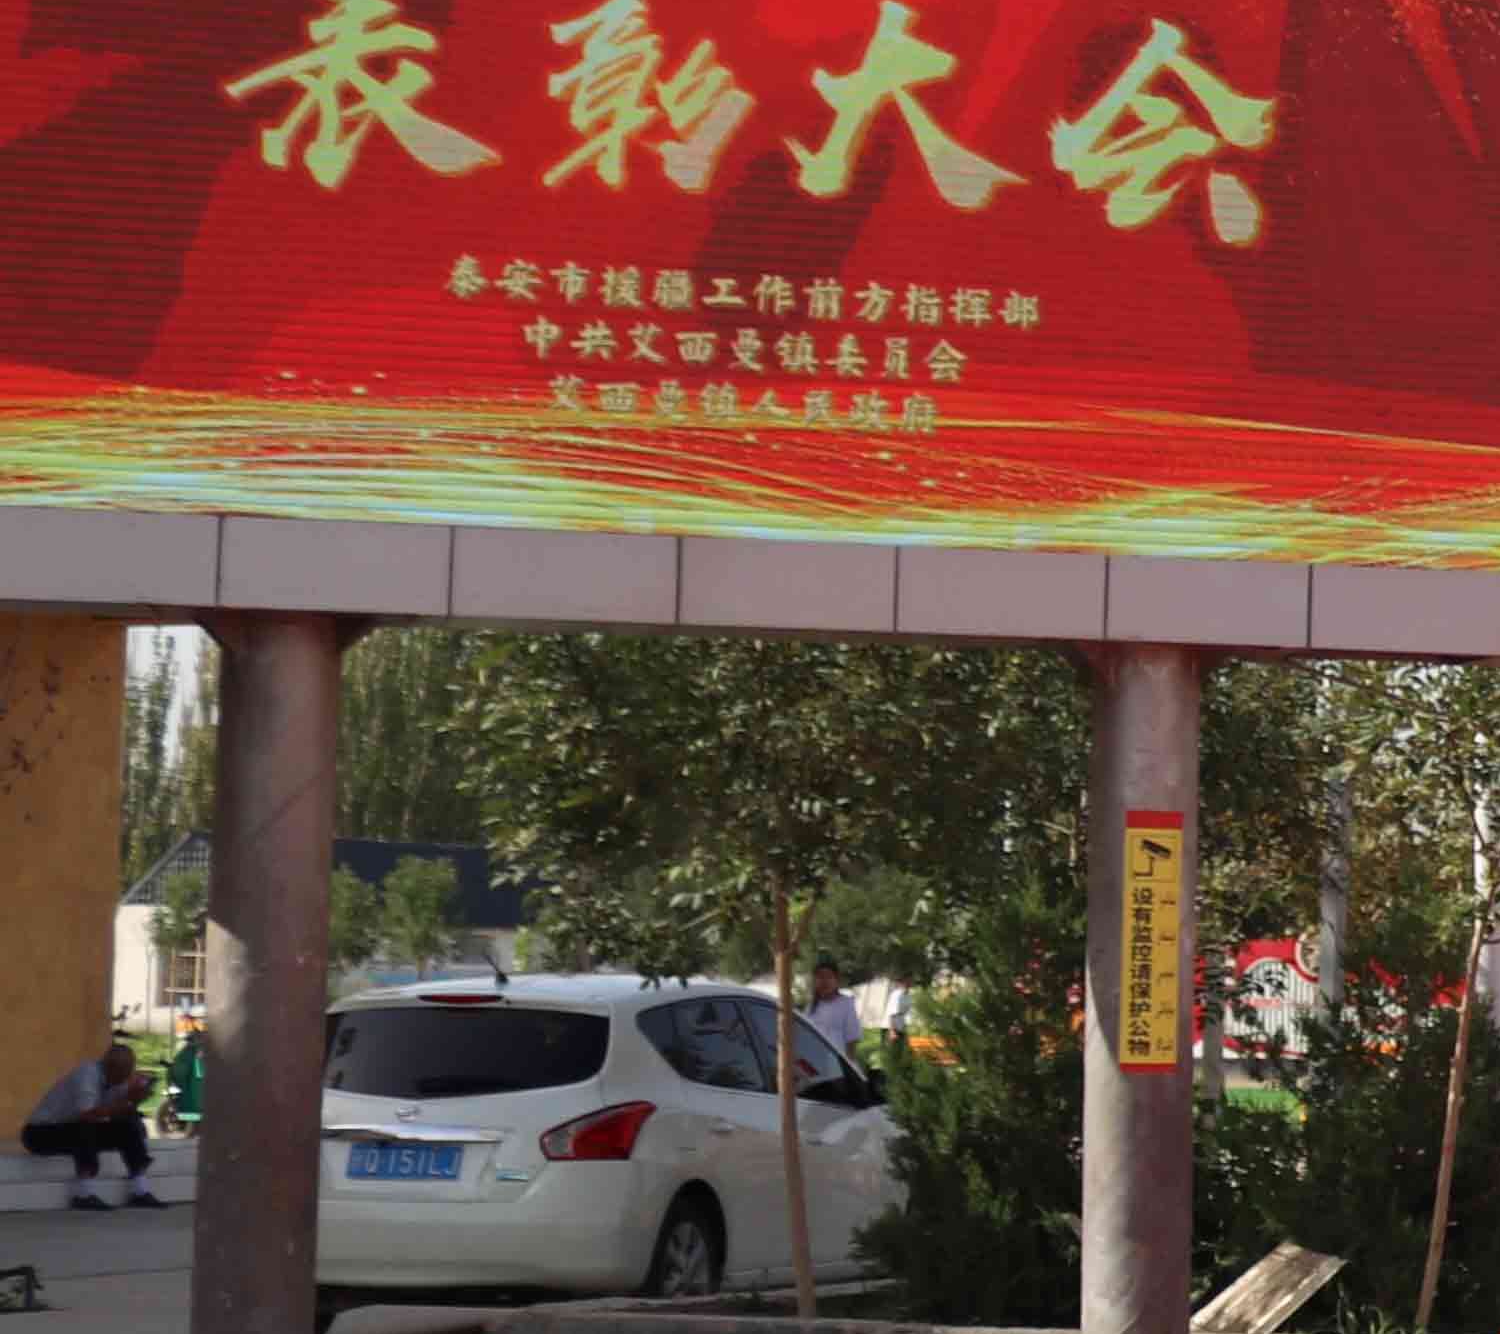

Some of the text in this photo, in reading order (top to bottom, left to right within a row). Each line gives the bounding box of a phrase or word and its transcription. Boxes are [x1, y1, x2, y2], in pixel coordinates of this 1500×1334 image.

[523, 315, 967, 381] 中共艾西曼镇委员会
